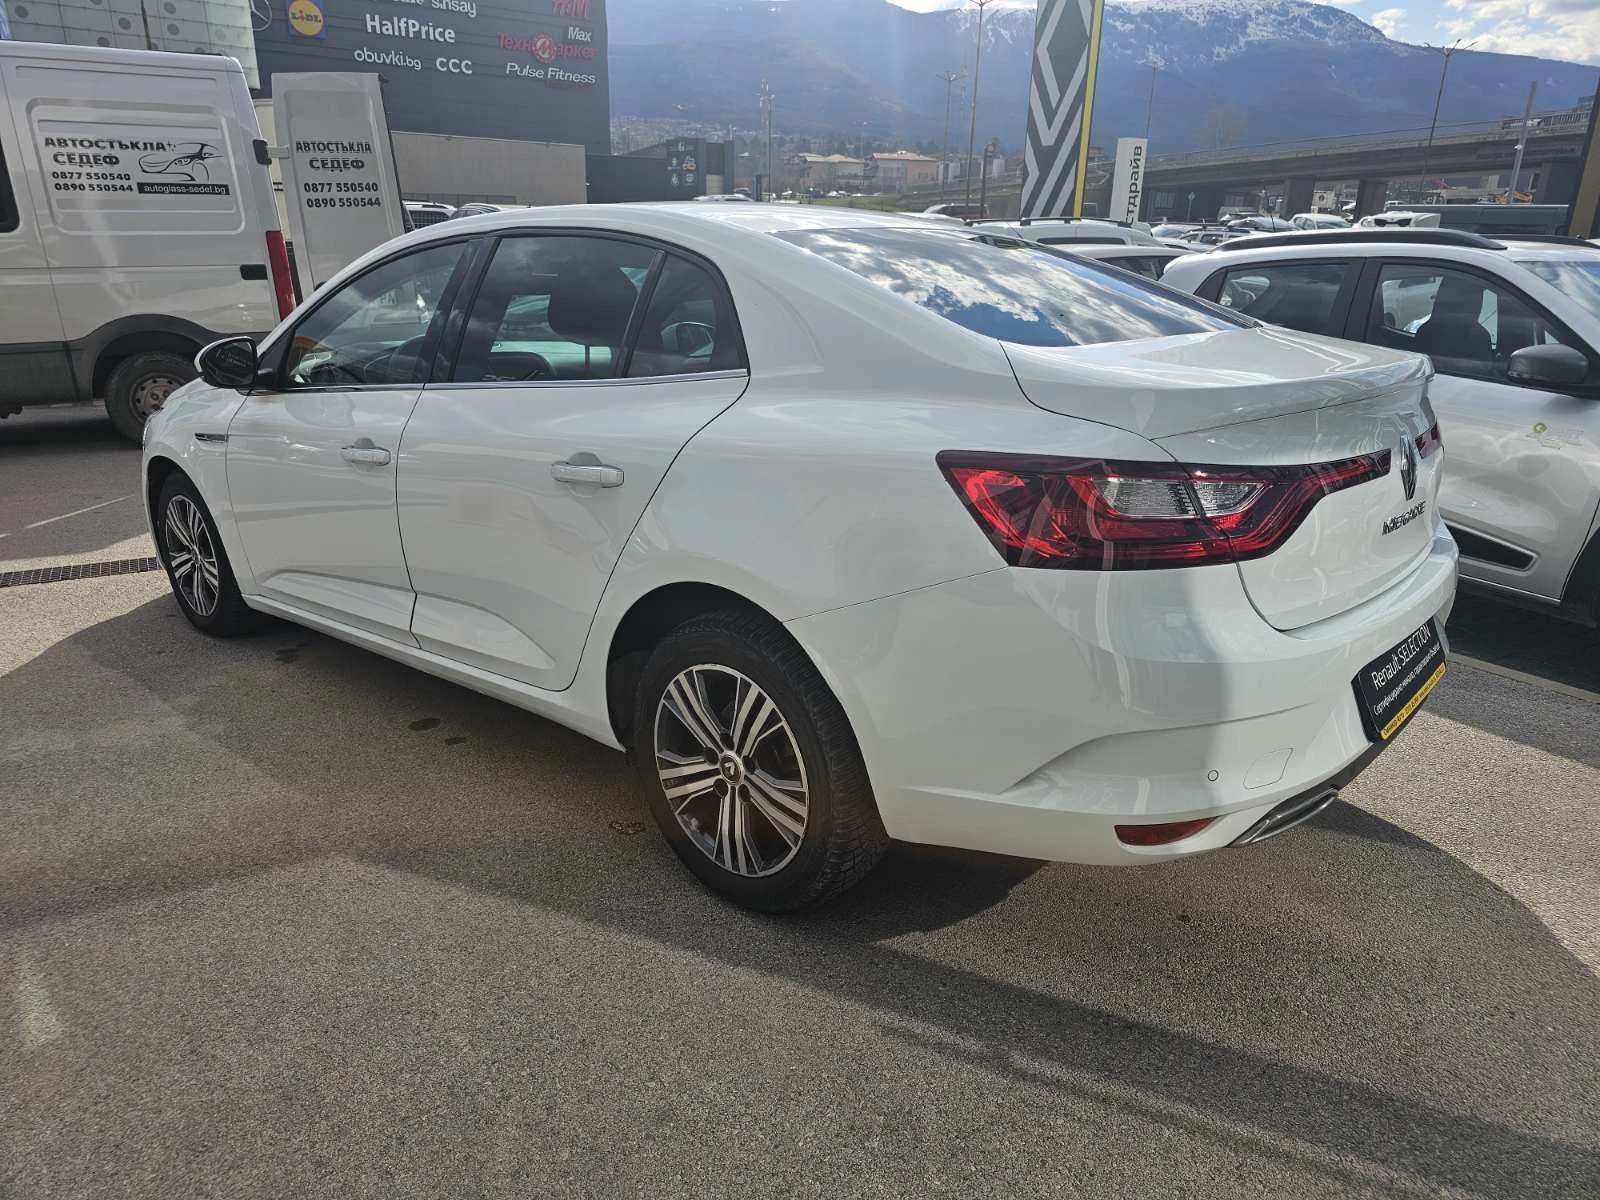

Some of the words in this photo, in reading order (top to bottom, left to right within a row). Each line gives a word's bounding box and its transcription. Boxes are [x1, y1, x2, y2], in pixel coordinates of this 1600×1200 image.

[365, 13, 456, 43] HalfPrice
[568, 26, 592, 42] Max
[354, 47, 422, 70] obuvki.bg
[506, 62, 544, 78] Pulse
[547, 67, 596, 83] Fitness
[53, 152, 120, 168] СЕДЕФ
[309, 158, 365, 172] СЕДЕФ
[52, 172, 82, 180] 0877
[86, 172, 131, 181] 550540
[54, 183, 86, 191] 0890
[88, 183, 134, 192] 550544
[304, 182, 332, 192] 0877
[336, 182, 378, 192] 550540
[307, 198, 336, 208] 0890
[339, 197, 381, 207] 550544
[1371, 653, 1402, 690] Renault
[1397, 624, 1431, 666] SELECTION
